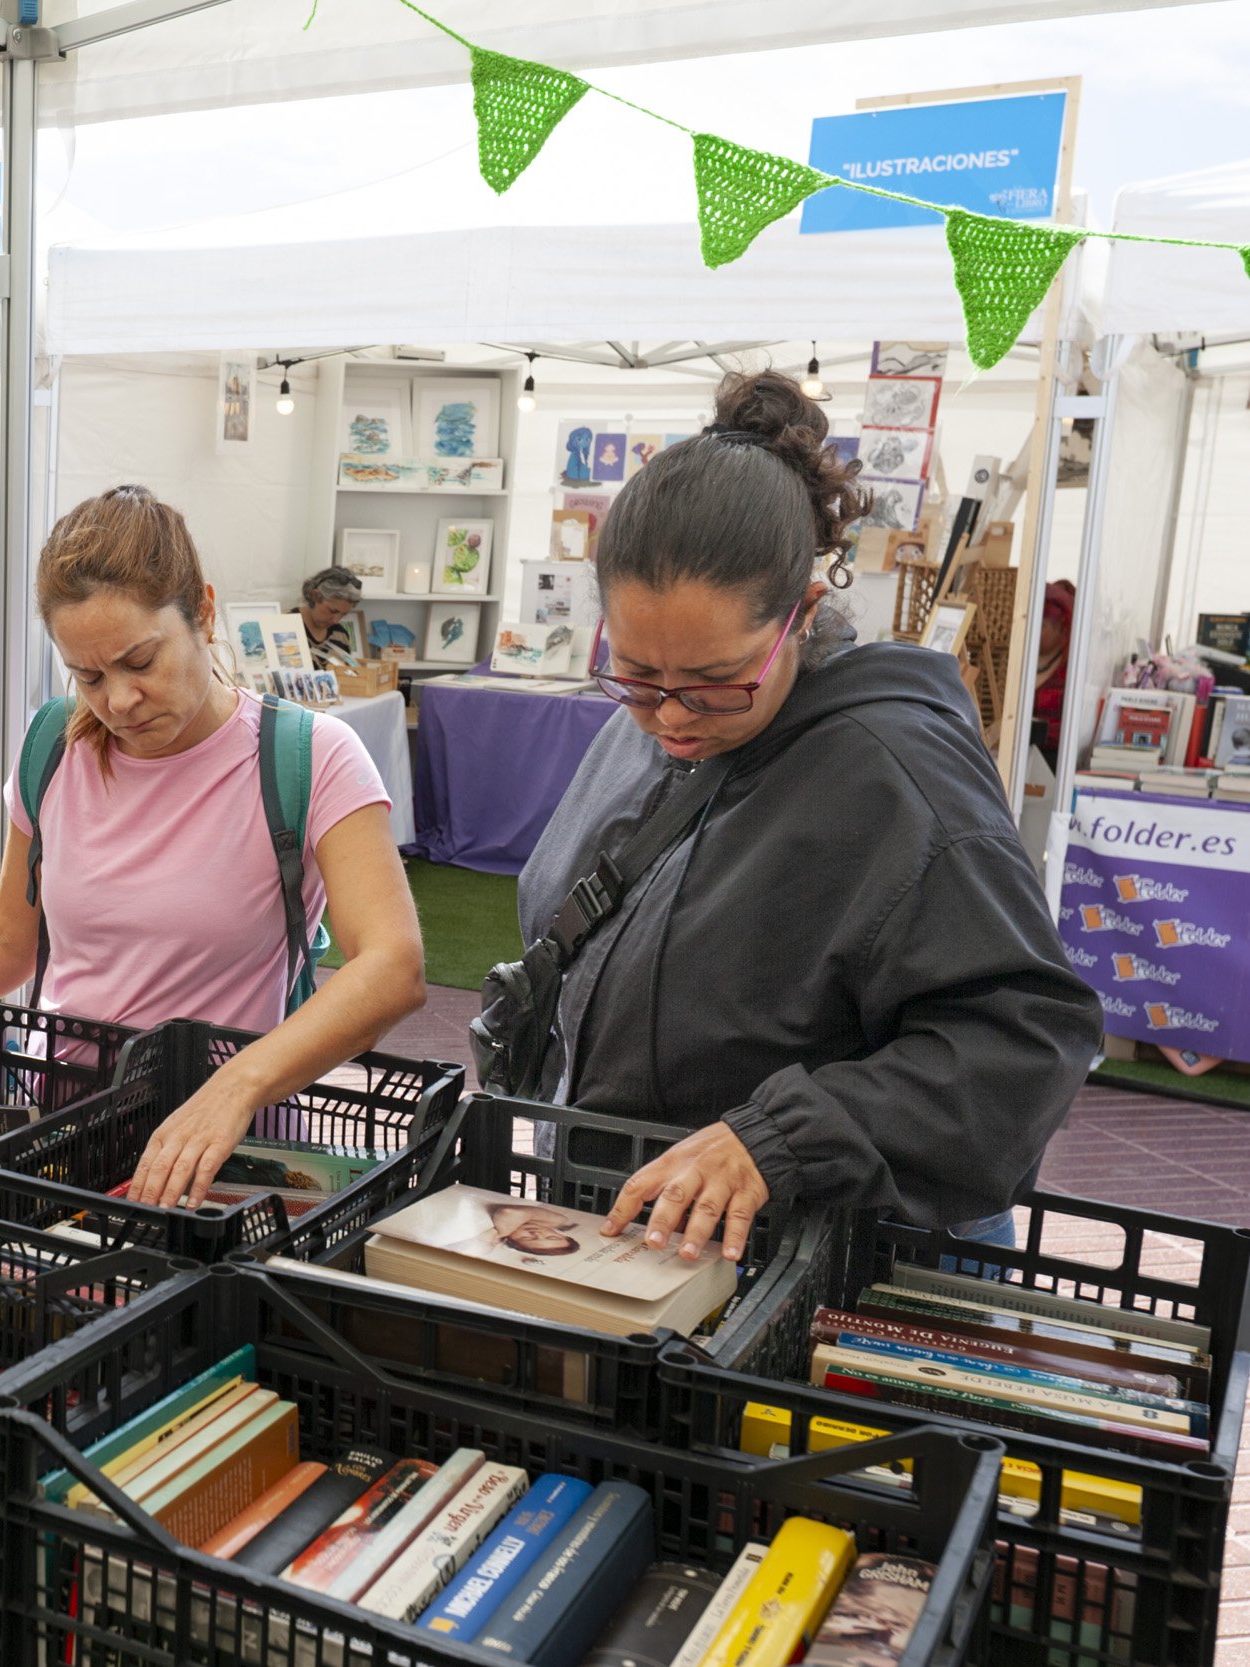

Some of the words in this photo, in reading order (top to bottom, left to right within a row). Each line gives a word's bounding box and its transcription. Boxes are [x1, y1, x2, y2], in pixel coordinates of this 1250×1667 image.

[843, 148, 1020, 179] "ILUSTRACIONES"
[827, 1313, 904, 1332] MONTIJO
[909, 1327, 935, 1340] DE
[940, 1333, 1015, 1355] EUGENIA
[842, 1367, 863, 1378] No
[865, 1373, 878, 1381] es
[959, 1372, 1036, 1397] REBELDE
[347, 1456, 377, 1469] SALAS
[349, 1451, 383, 1465] EMILIO
[444, 1577, 494, 1618] MICHAEL
[477, 1535, 526, 1580] CONNELLY
[883, 1562, 918, 1578] John
[859, 1567, 931, 1593] GRISHAM
